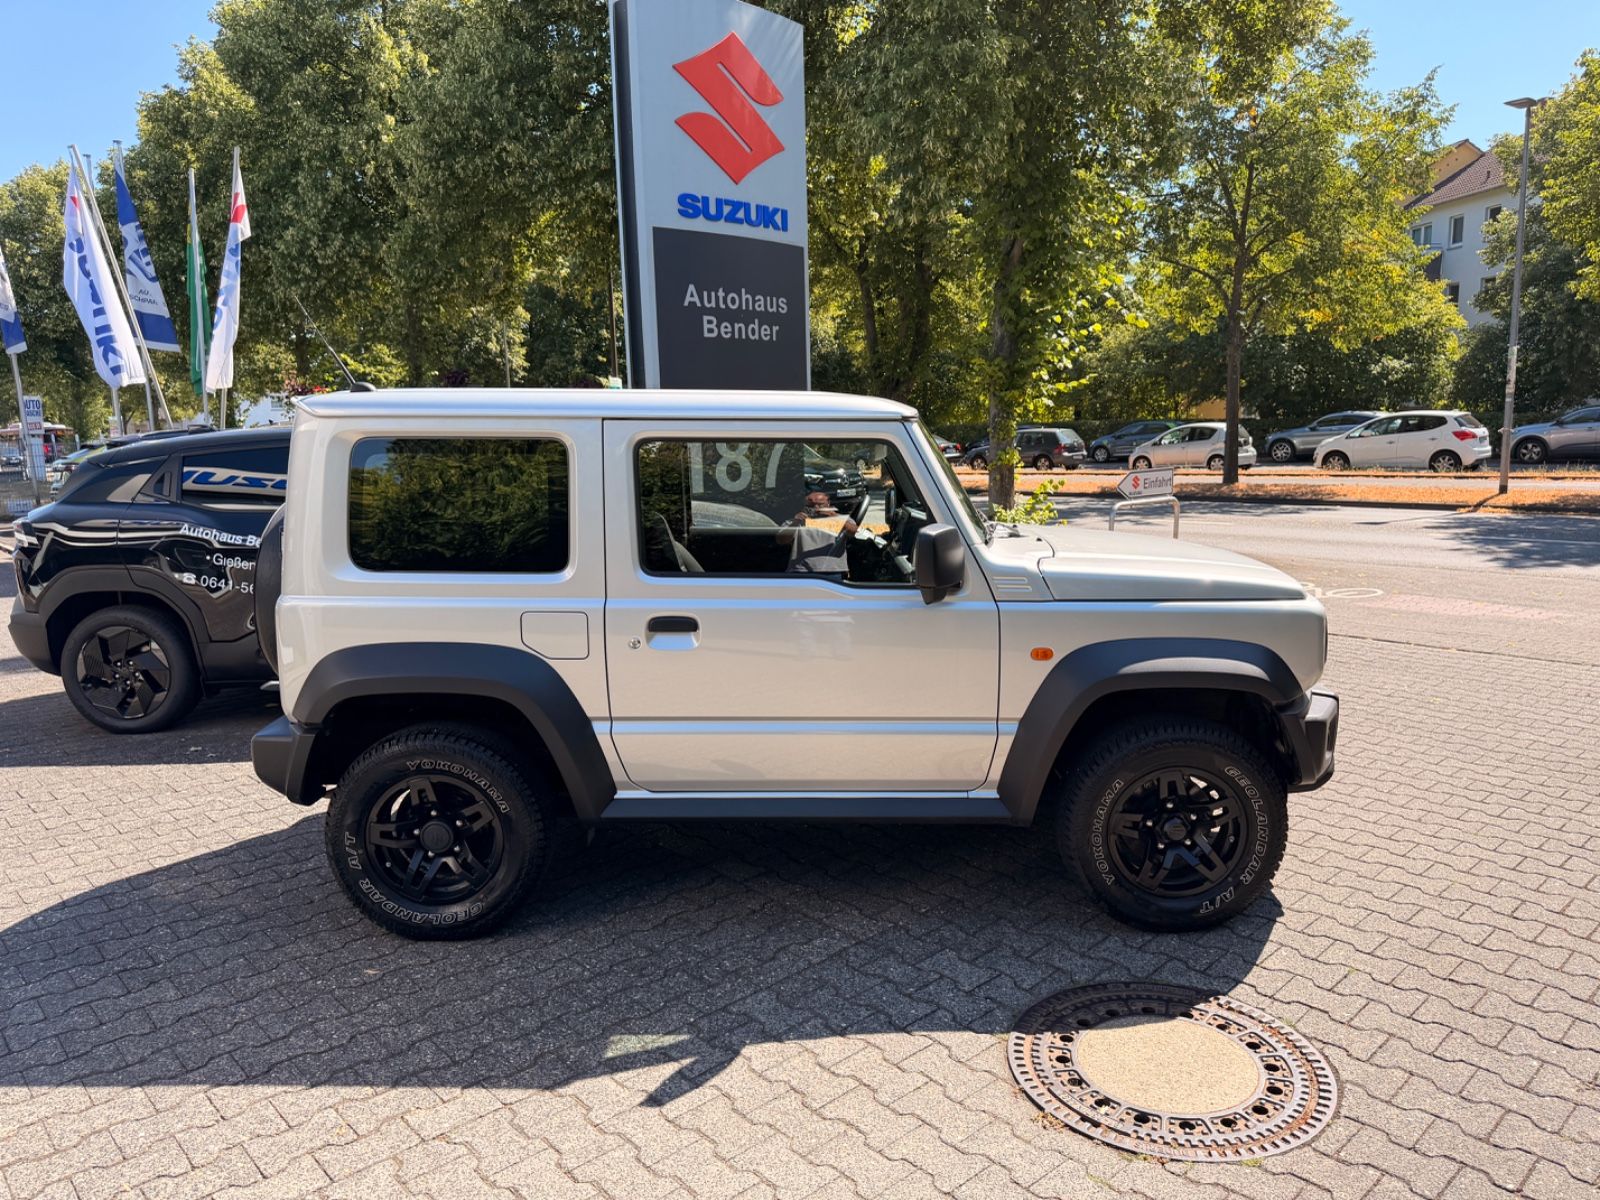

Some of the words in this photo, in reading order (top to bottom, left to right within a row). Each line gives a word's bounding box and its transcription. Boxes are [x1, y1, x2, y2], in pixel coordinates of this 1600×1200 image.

[678, 193, 788, 232] SUZUKI
[683, 284, 788, 314] Autohaus
[702, 315, 779, 341] Bender
[1143, 476, 1172, 490] Einfahrt
[179, 523, 243, 545] Autohaus
[406, 758, 511, 814] YOKOHAMA
[1091, 778, 1125, 885] YOKOHAMA
[1224, 766, 1268, 885] GEOLANDAR
[344, 831, 362, 870] A/T
[358, 878, 484, 925] GEOLANDAR
[1200, 886, 1236, 914] A/T
